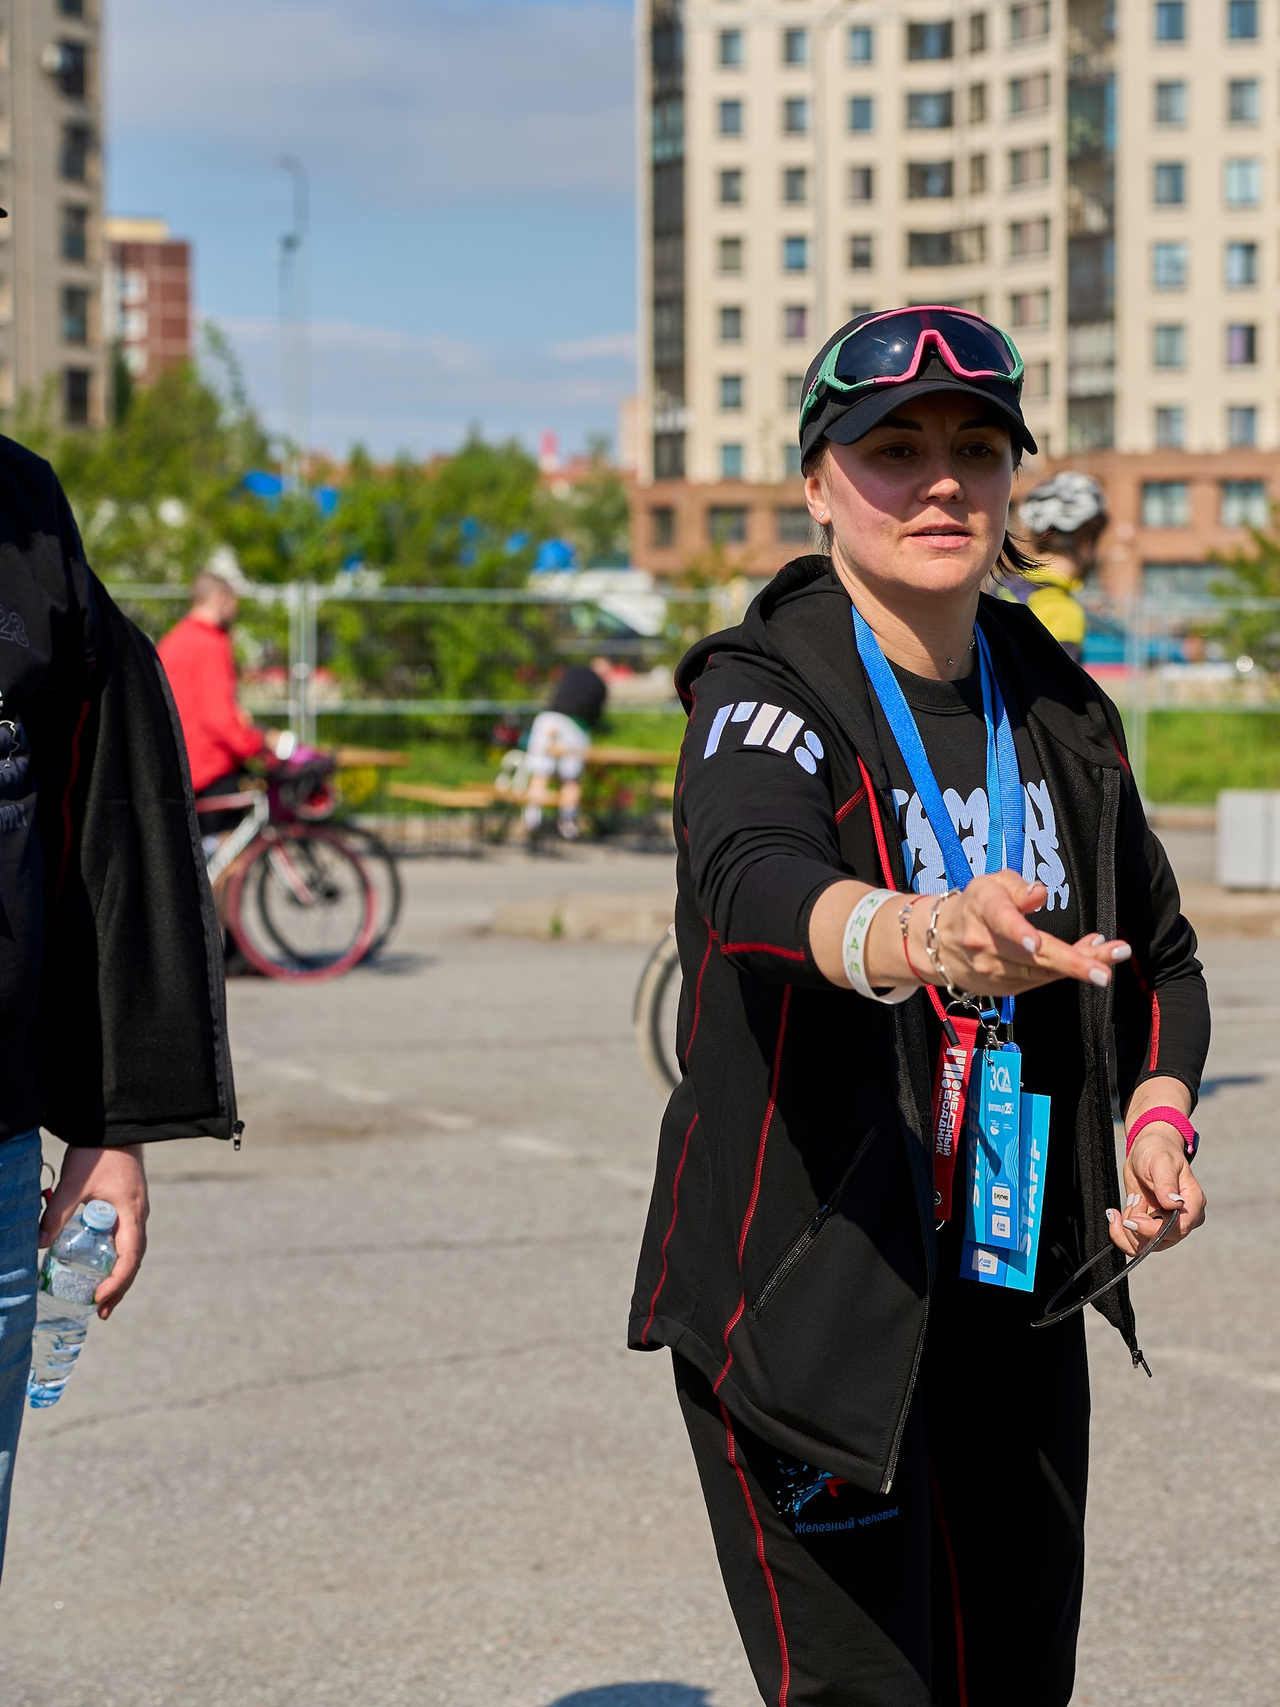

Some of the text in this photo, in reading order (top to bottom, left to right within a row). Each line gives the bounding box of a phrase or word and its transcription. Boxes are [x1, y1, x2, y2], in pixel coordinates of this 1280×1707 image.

[936, 1089, 952, 1155] ВСАДНИК
[943, 1089, 961, 1157] МЕДНЫЙ
[969, 1087, 981, 1209] STAFF
[1019, 1135, 1041, 1256] STAFF
[795, 1506, 899, 1534] Железный человек
